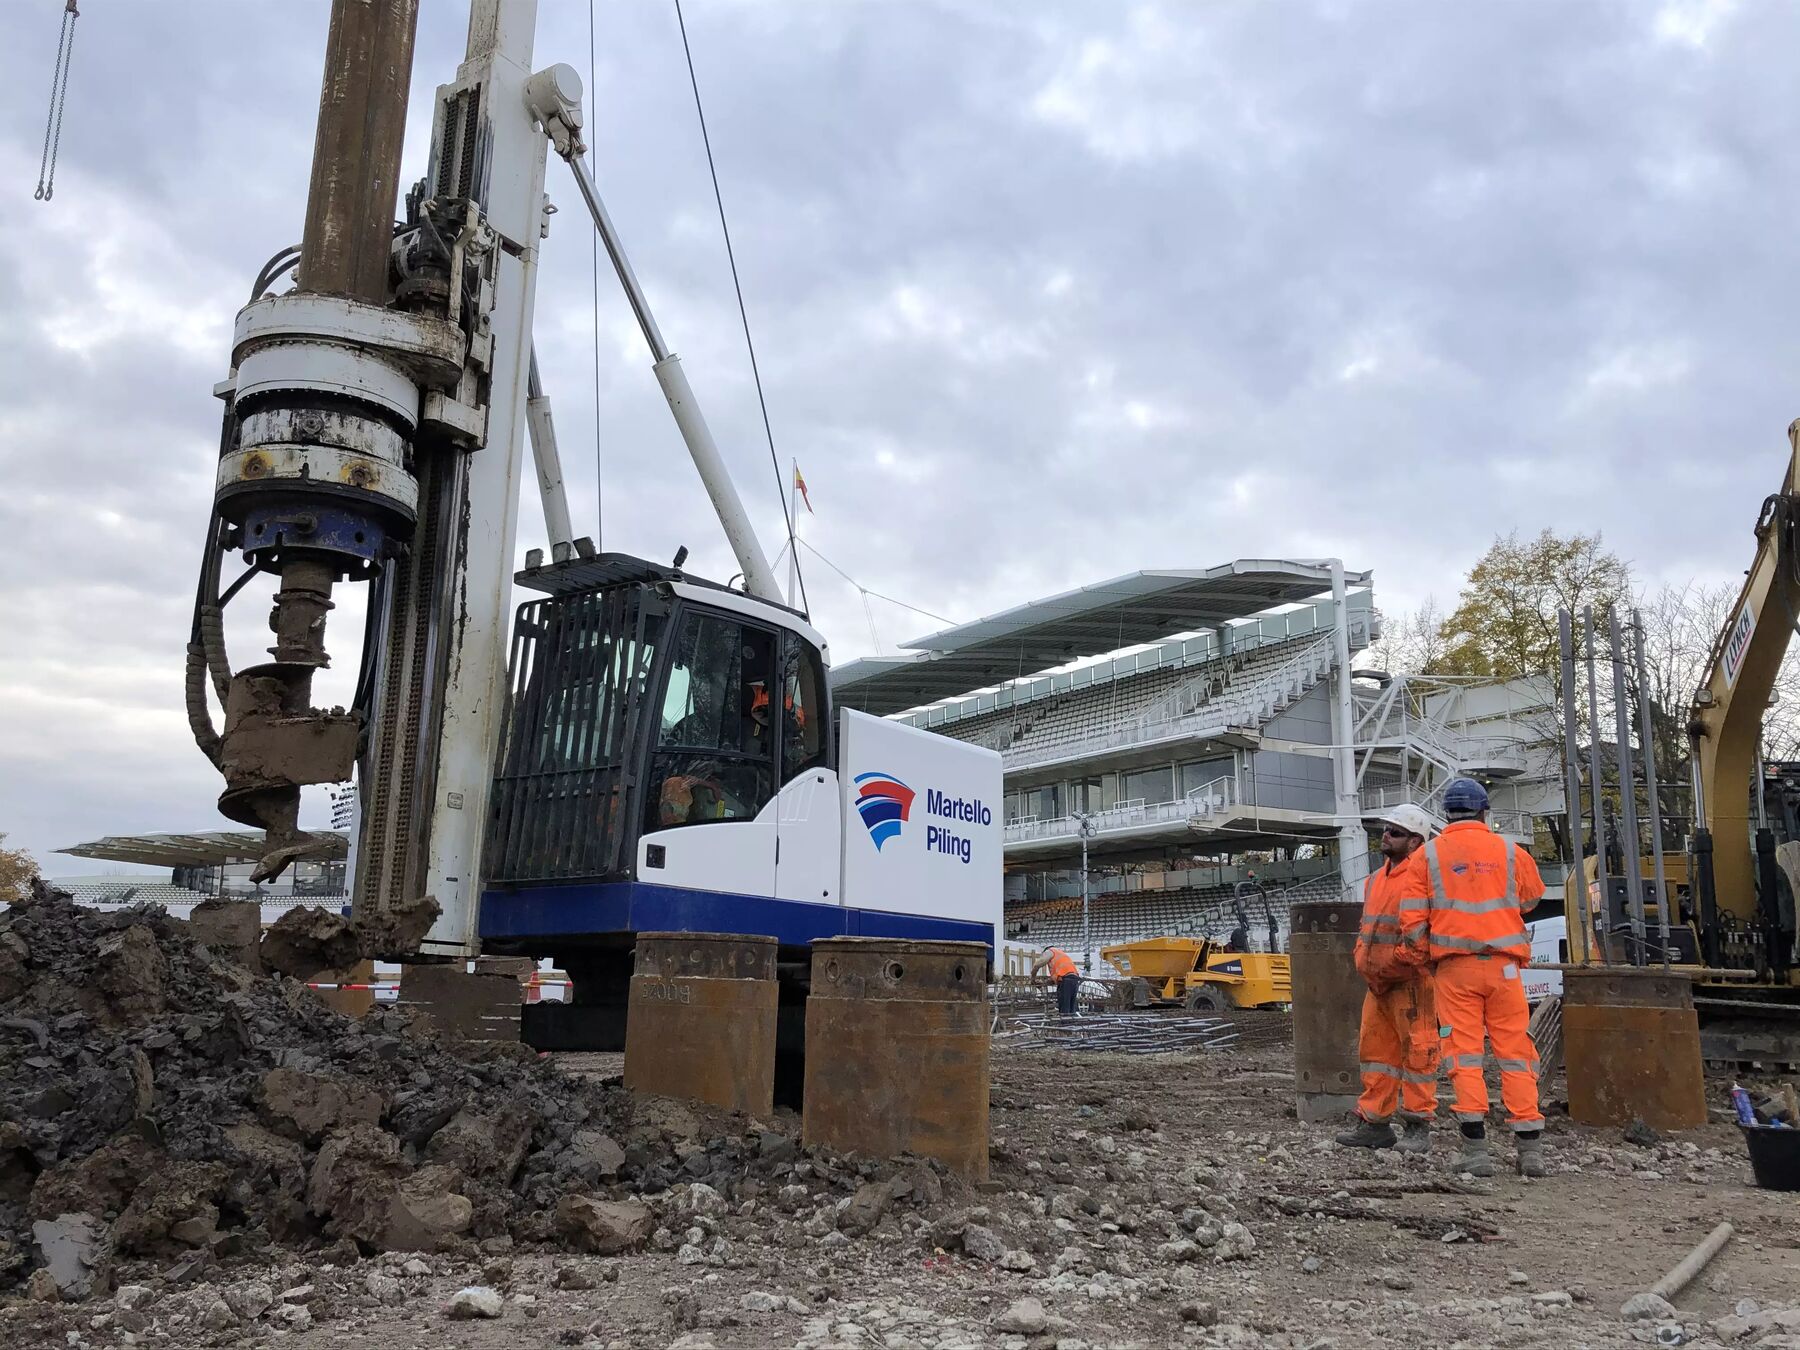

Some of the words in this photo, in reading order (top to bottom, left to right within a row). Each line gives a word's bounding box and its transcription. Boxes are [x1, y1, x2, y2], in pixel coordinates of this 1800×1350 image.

[927, 788, 991, 826] Martello
[927, 825, 971, 864] Piling
[1528, 982, 1550, 995] SERVICE
